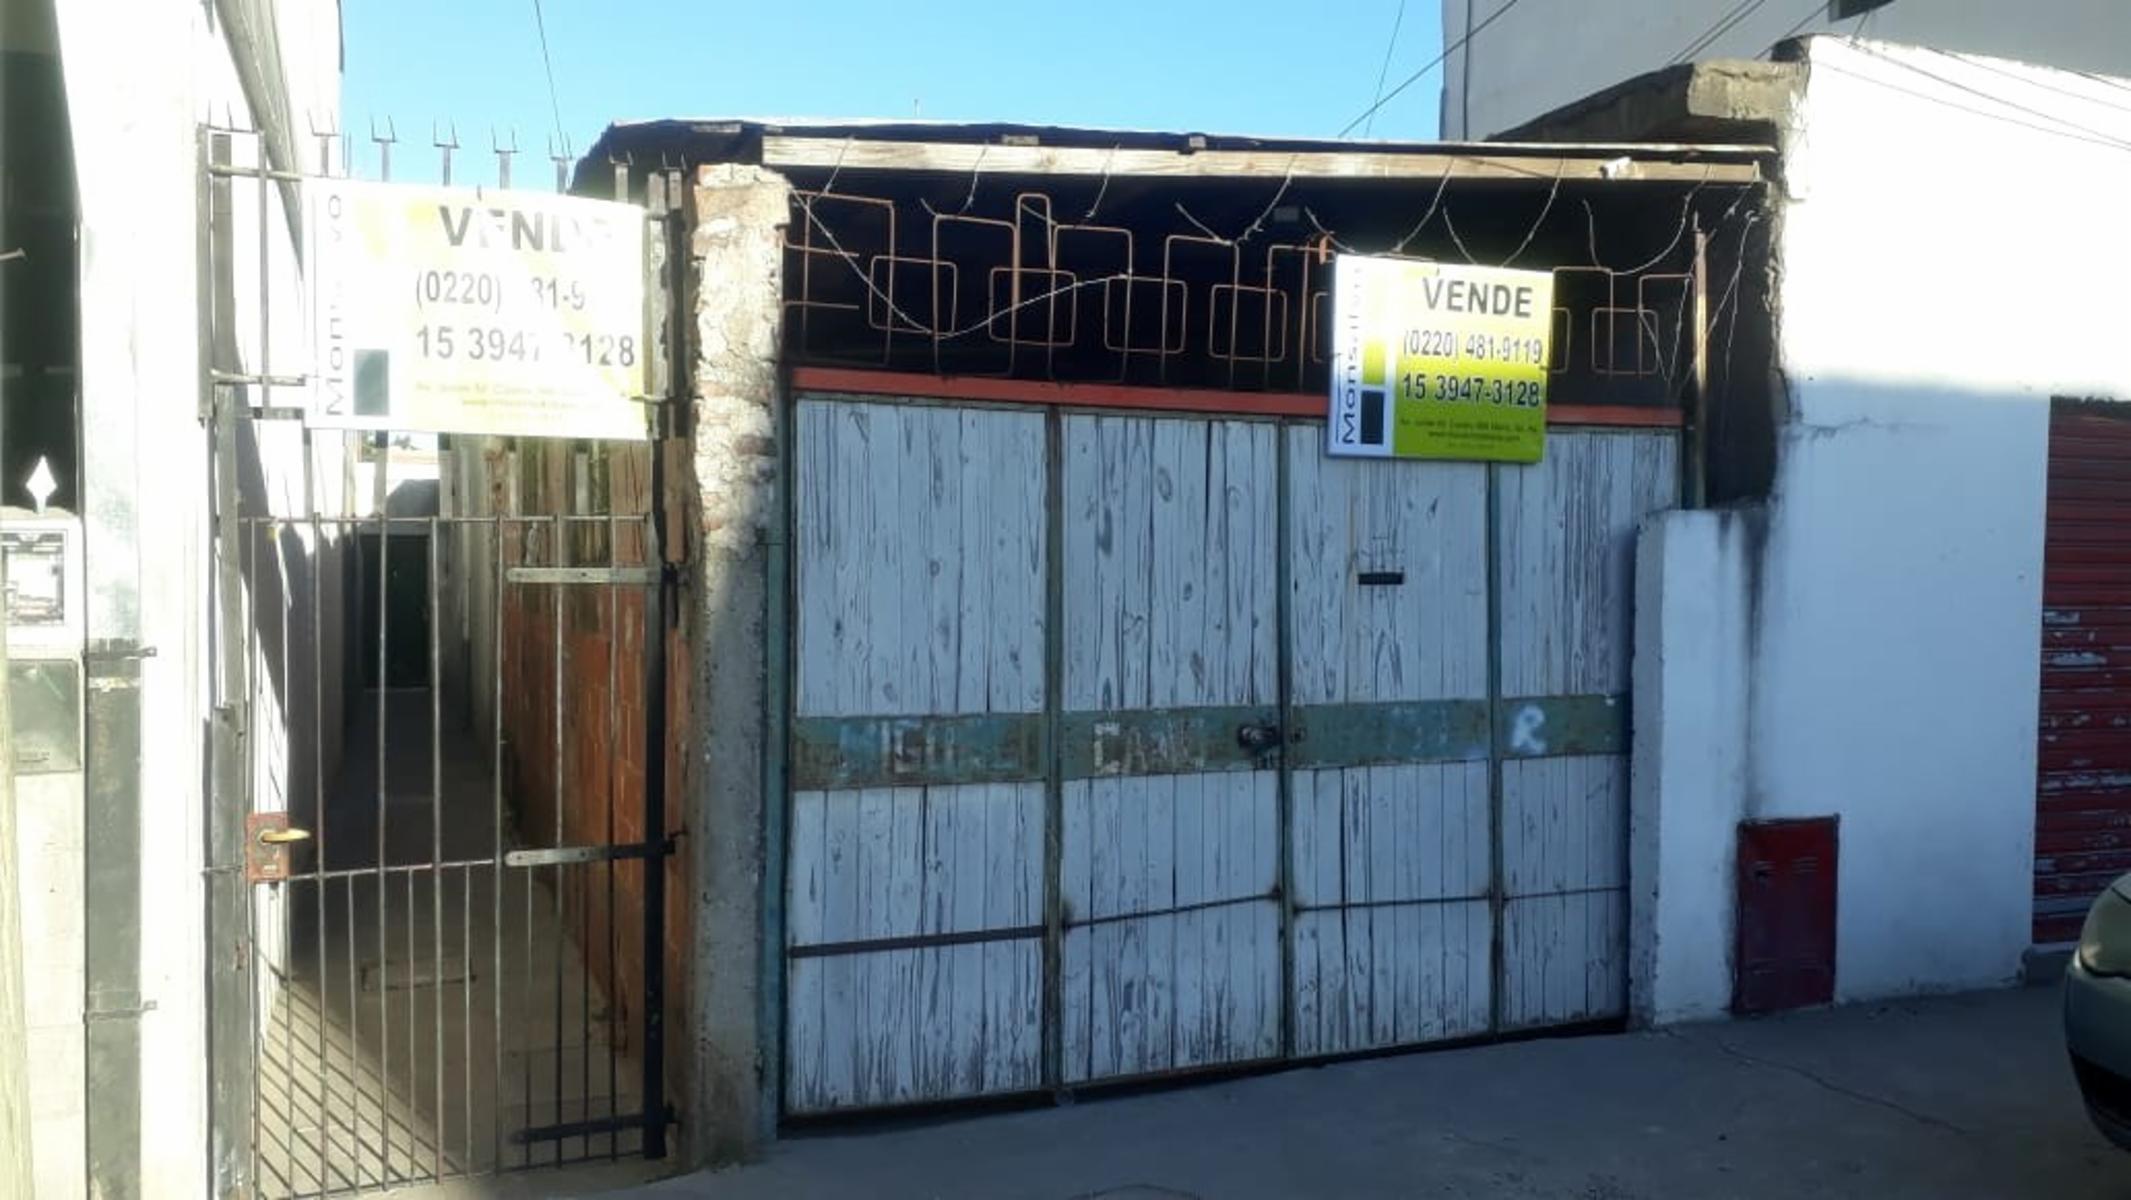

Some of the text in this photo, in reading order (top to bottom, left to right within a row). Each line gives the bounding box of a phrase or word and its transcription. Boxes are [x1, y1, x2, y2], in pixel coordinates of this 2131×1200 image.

[415, 270, 502, 314] (0220)
[1422, 276, 1534, 319] VENDE
[416, 324, 456, 360] 15
[1402, 328, 1543, 365] (0220) 481-9119
[1402, 372, 1541, 408] 15 3947-3128
